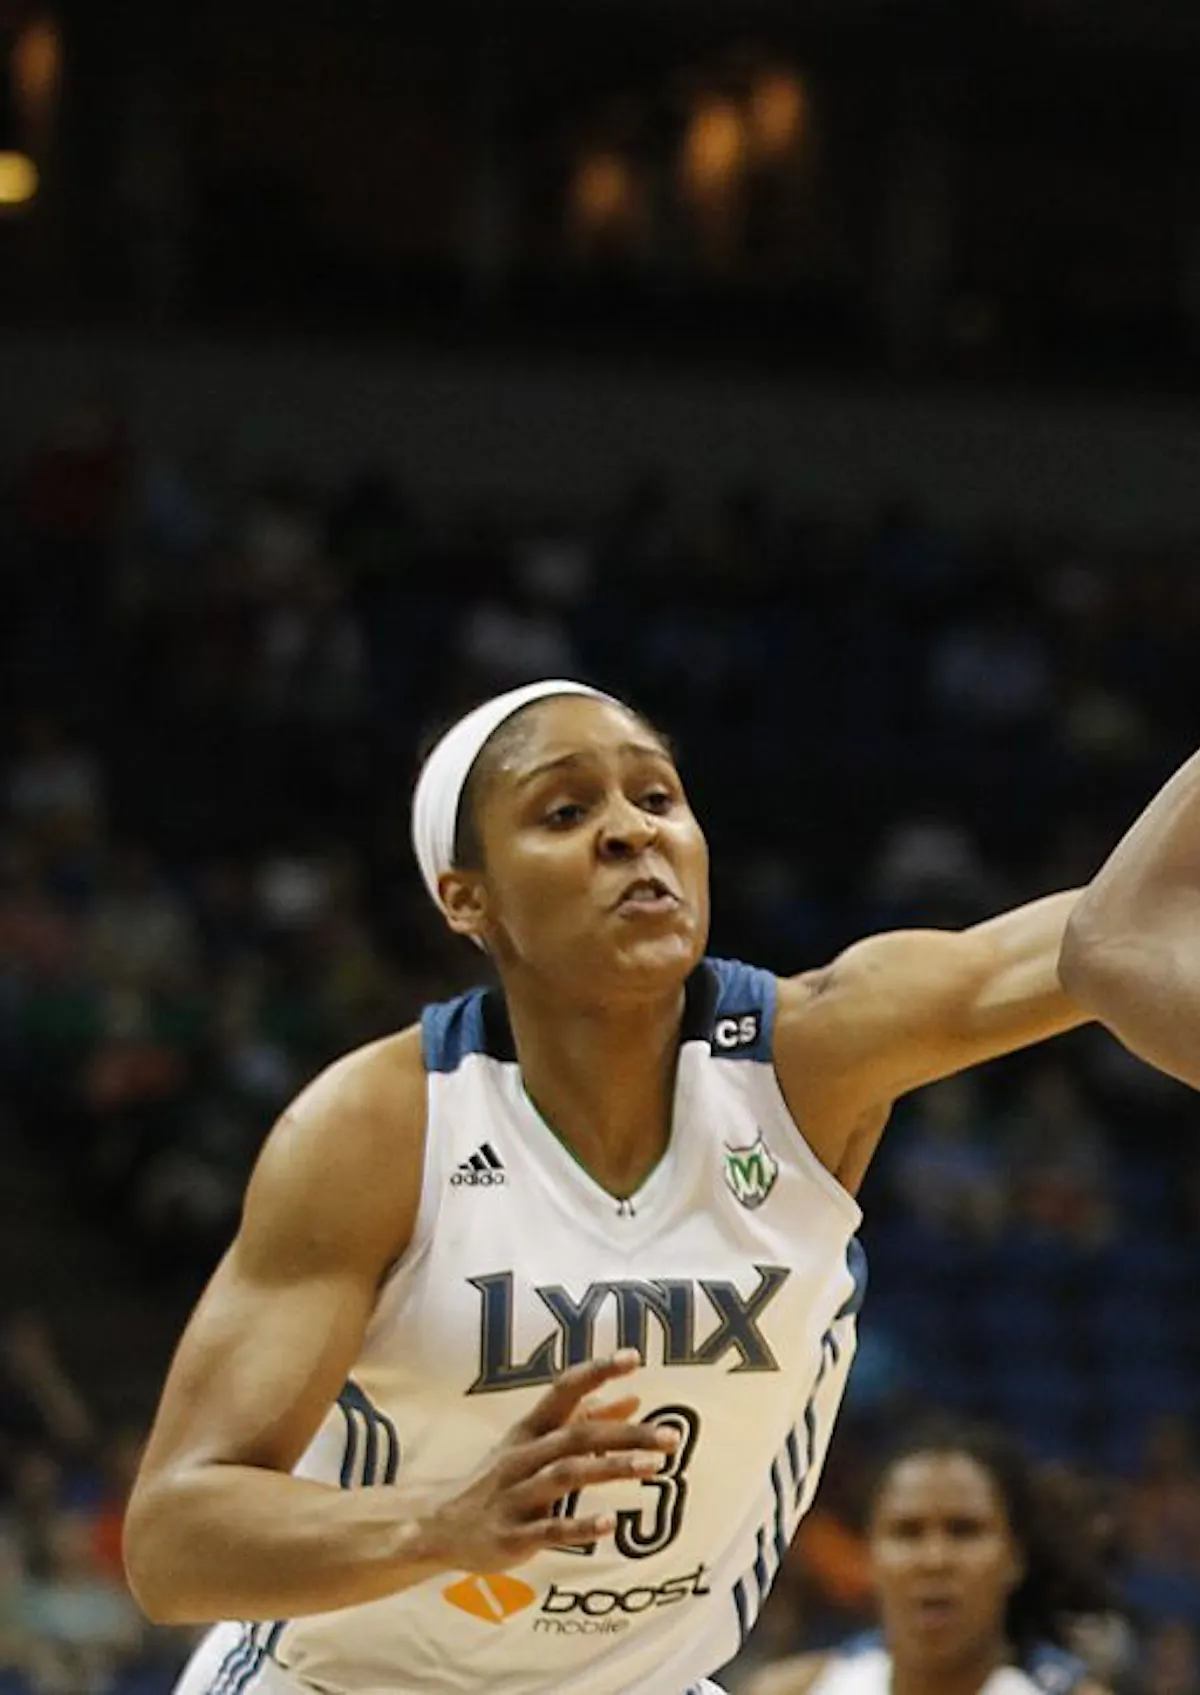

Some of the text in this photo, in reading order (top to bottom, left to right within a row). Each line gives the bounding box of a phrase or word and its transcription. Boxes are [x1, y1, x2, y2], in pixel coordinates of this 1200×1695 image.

[464, 1263, 791, 1396] LYNX
[548, 1404, 701, 1560] 3
[532, 1617, 630, 1635] mobile
[541, 1563, 711, 1616] boost
